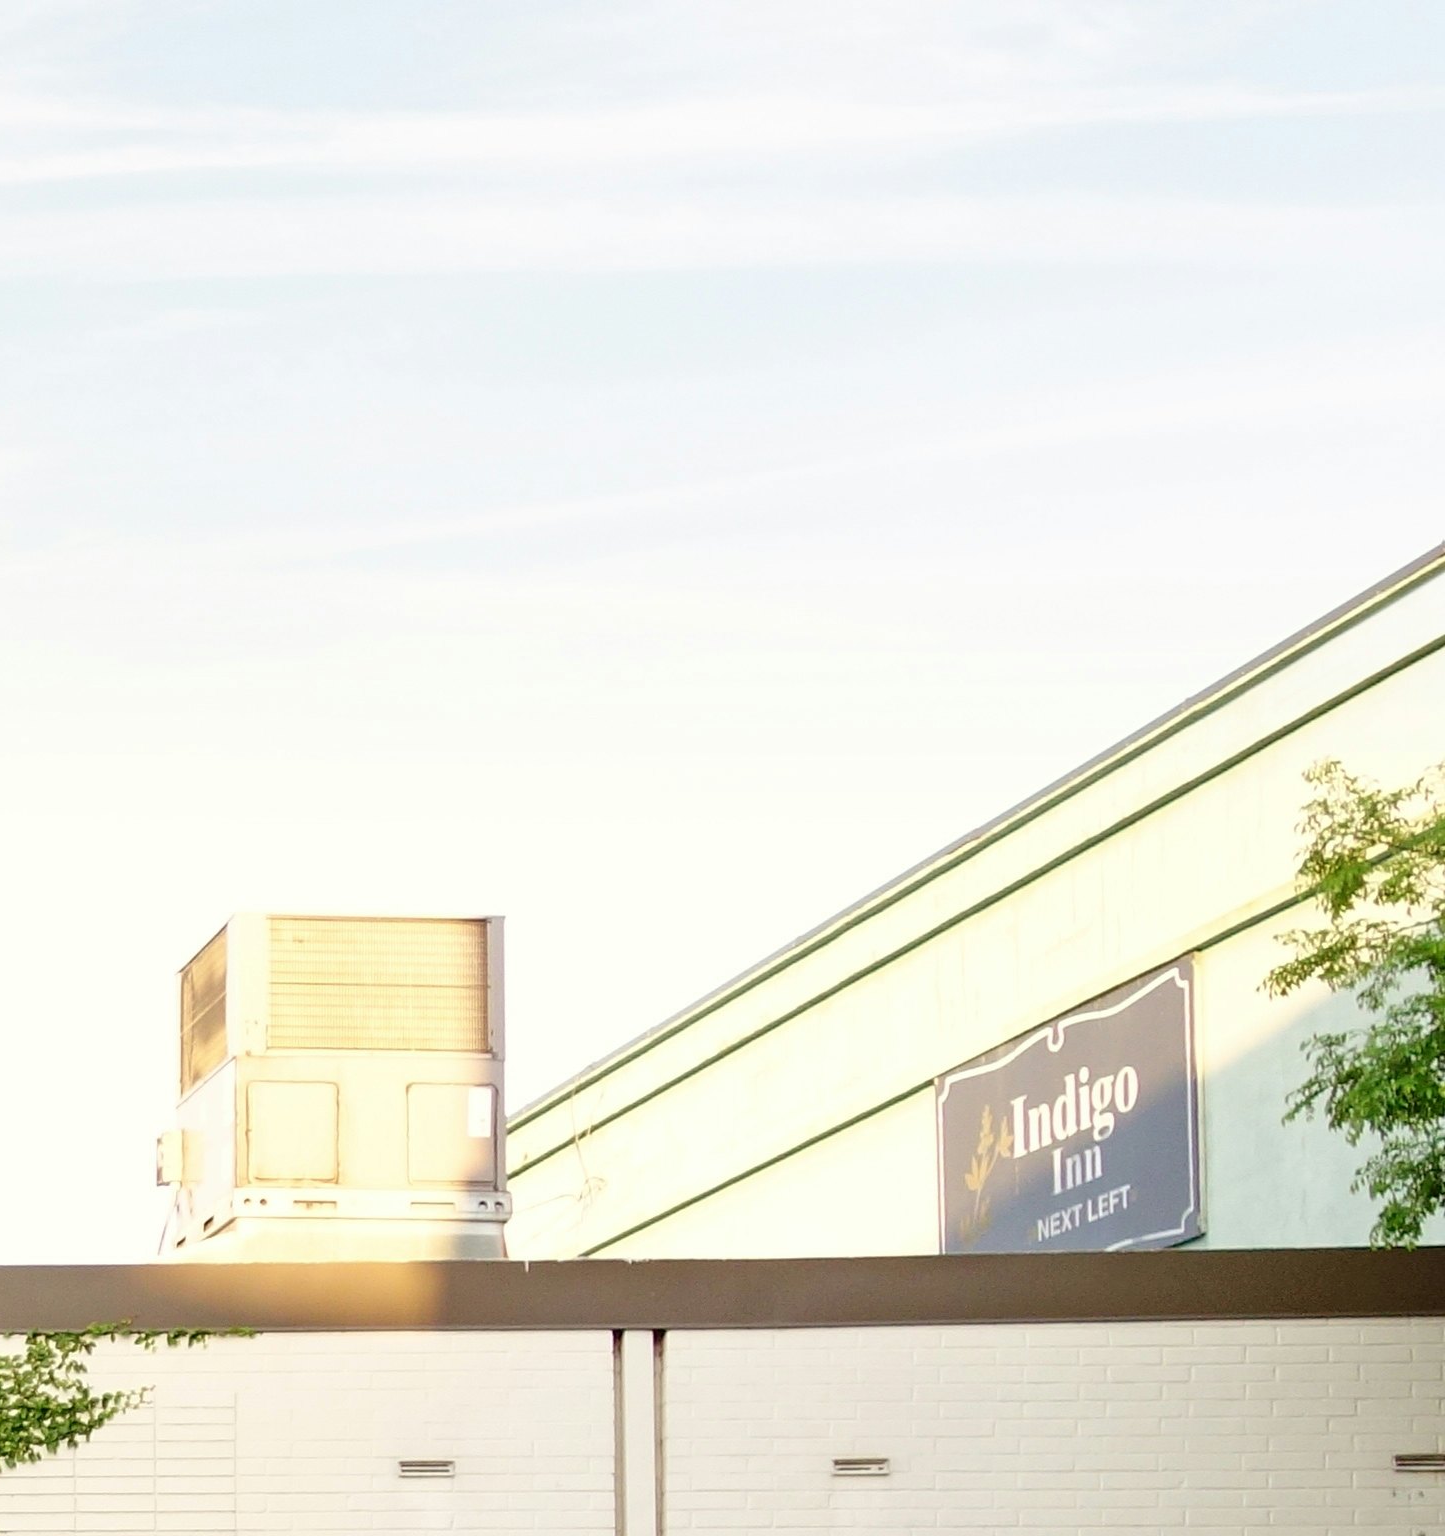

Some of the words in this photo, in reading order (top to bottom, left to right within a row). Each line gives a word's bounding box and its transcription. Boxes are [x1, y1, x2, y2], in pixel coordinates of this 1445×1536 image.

[1010, 1065, 1139, 1159] Indigo
[1052, 1144, 1103, 1196] Inn
[1036, 1203, 1083, 1242] NEXT
[1087, 1184, 1132, 1223] LEFT
